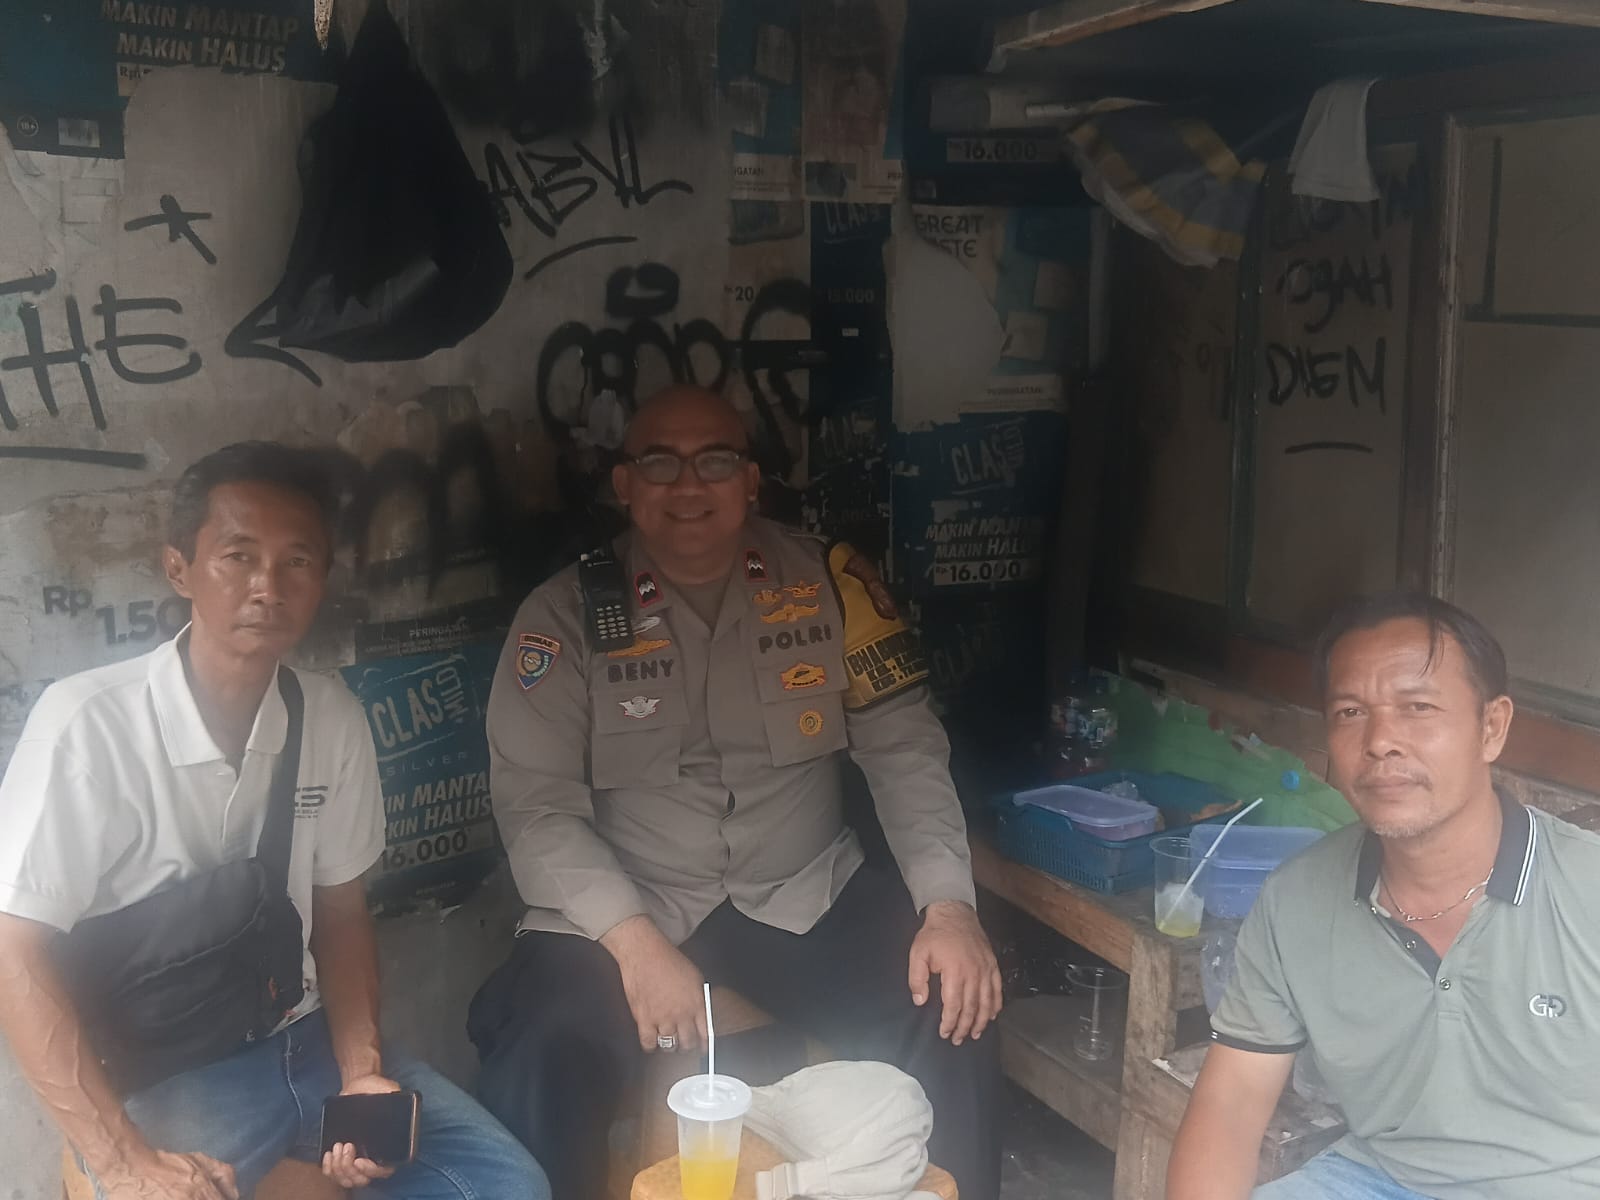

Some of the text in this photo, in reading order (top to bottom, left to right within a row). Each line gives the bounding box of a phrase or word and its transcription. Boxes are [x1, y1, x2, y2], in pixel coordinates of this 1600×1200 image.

[185, 4, 299, 42] MANTAP
[117, 33, 286, 71] MAKIN HALUS
[914, 214, 985, 235] GREAT
[949, 561, 1021, 582] 16.000
[43, 586, 92, 616] Rp
[758, 623, 833, 654] POLRI
[607, 659, 674, 684] BENY
[371, 678, 444, 748] CLAS
[424, 795, 491, 831] HALUS
